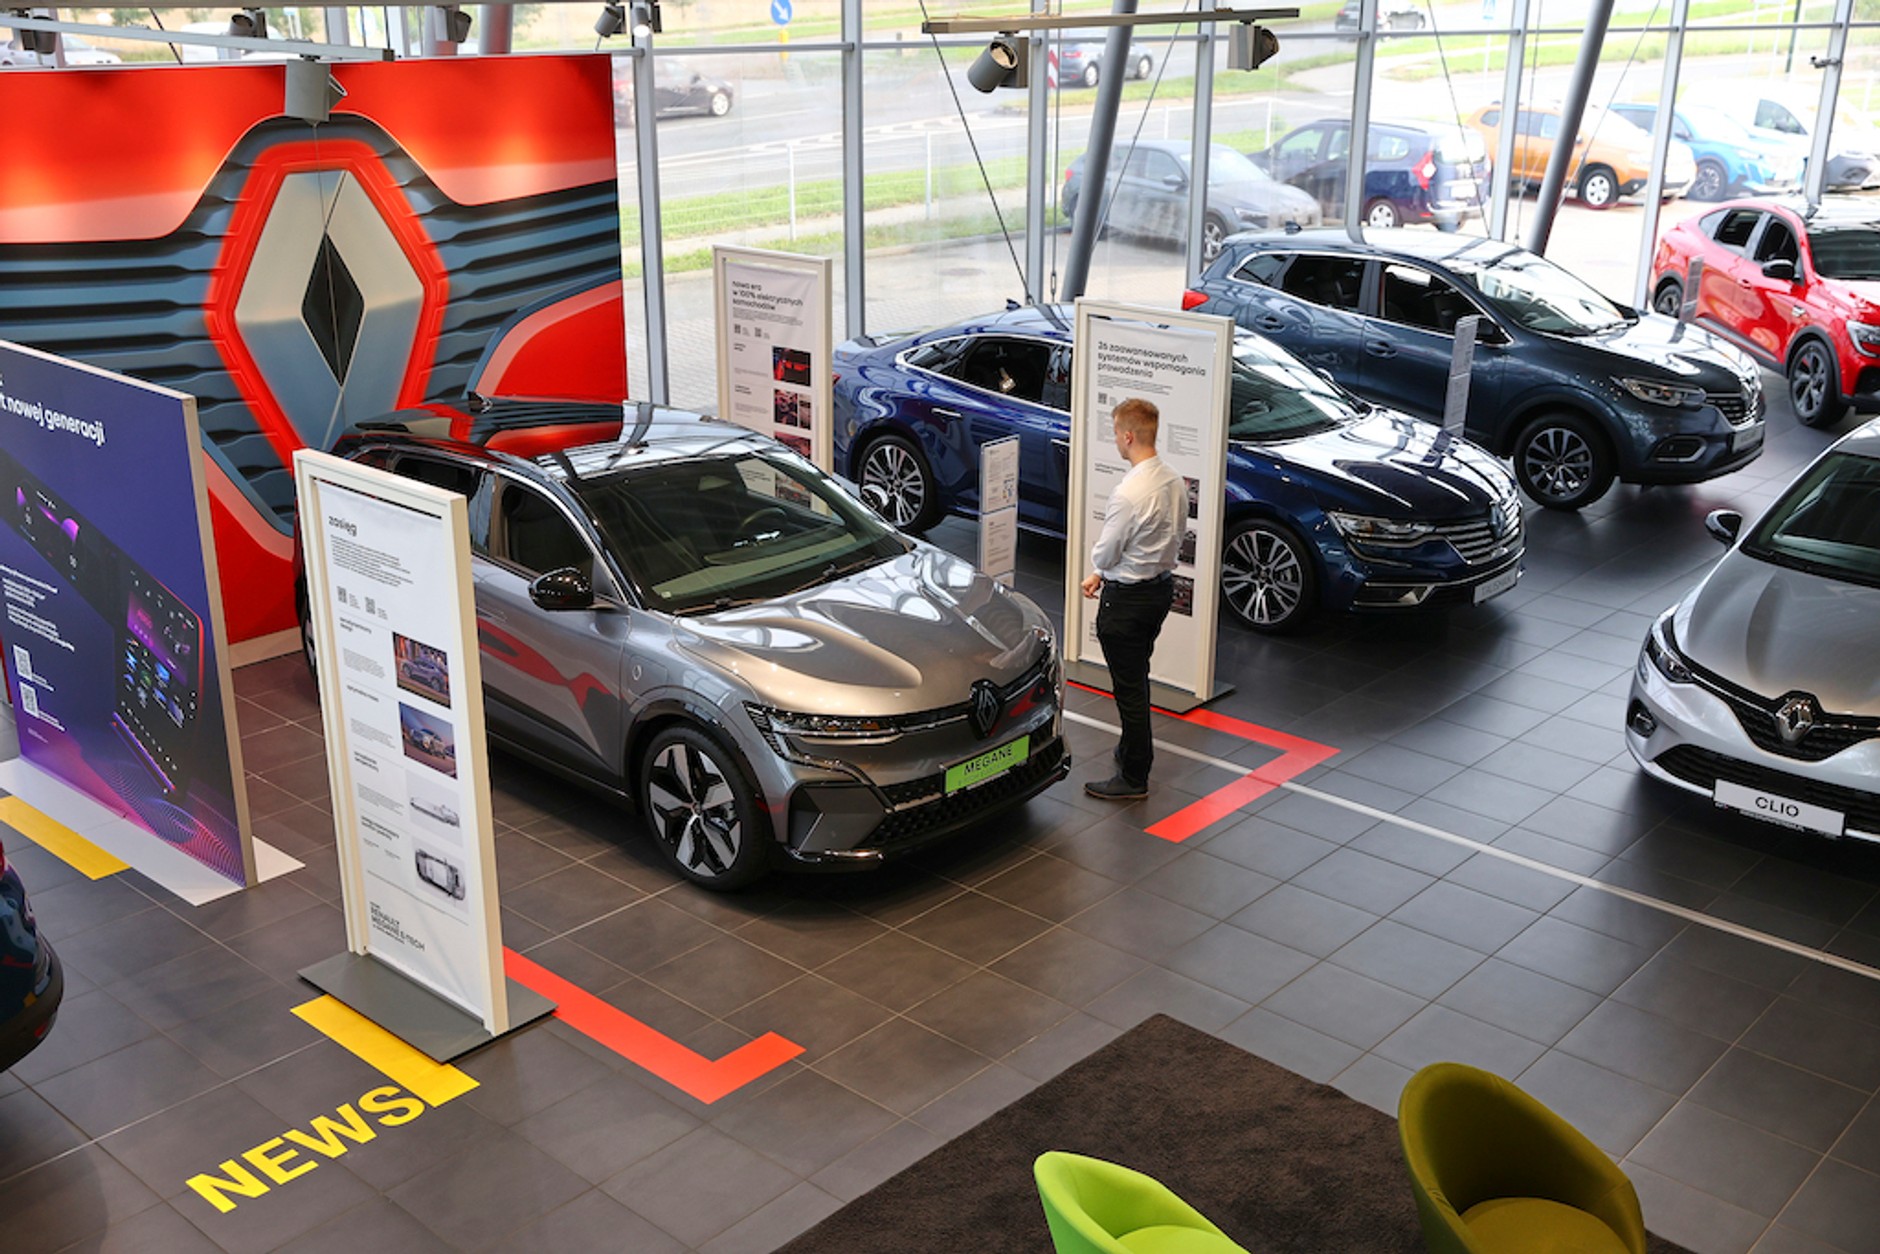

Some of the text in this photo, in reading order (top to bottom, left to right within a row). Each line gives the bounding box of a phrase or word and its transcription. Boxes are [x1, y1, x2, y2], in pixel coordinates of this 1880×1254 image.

[732, 298, 776, 311] samochodów
[756, 293, 804, 307] elektrycznych
[1109, 343, 1188, 362] zaawansowanych
[1098, 352, 1206, 377] systemów wspomagania
[1098, 362, 1153, 378] prowadzenia
[7, 396, 44, 428] nowej
[44, 409, 106, 447] generacji
[328, 515, 358, 537] zasięg
[964, 744, 1013, 776] MEGANE
[1755, 796, 1800, 818] CLIO
[185, 1085, 426, 1214] NEWS
